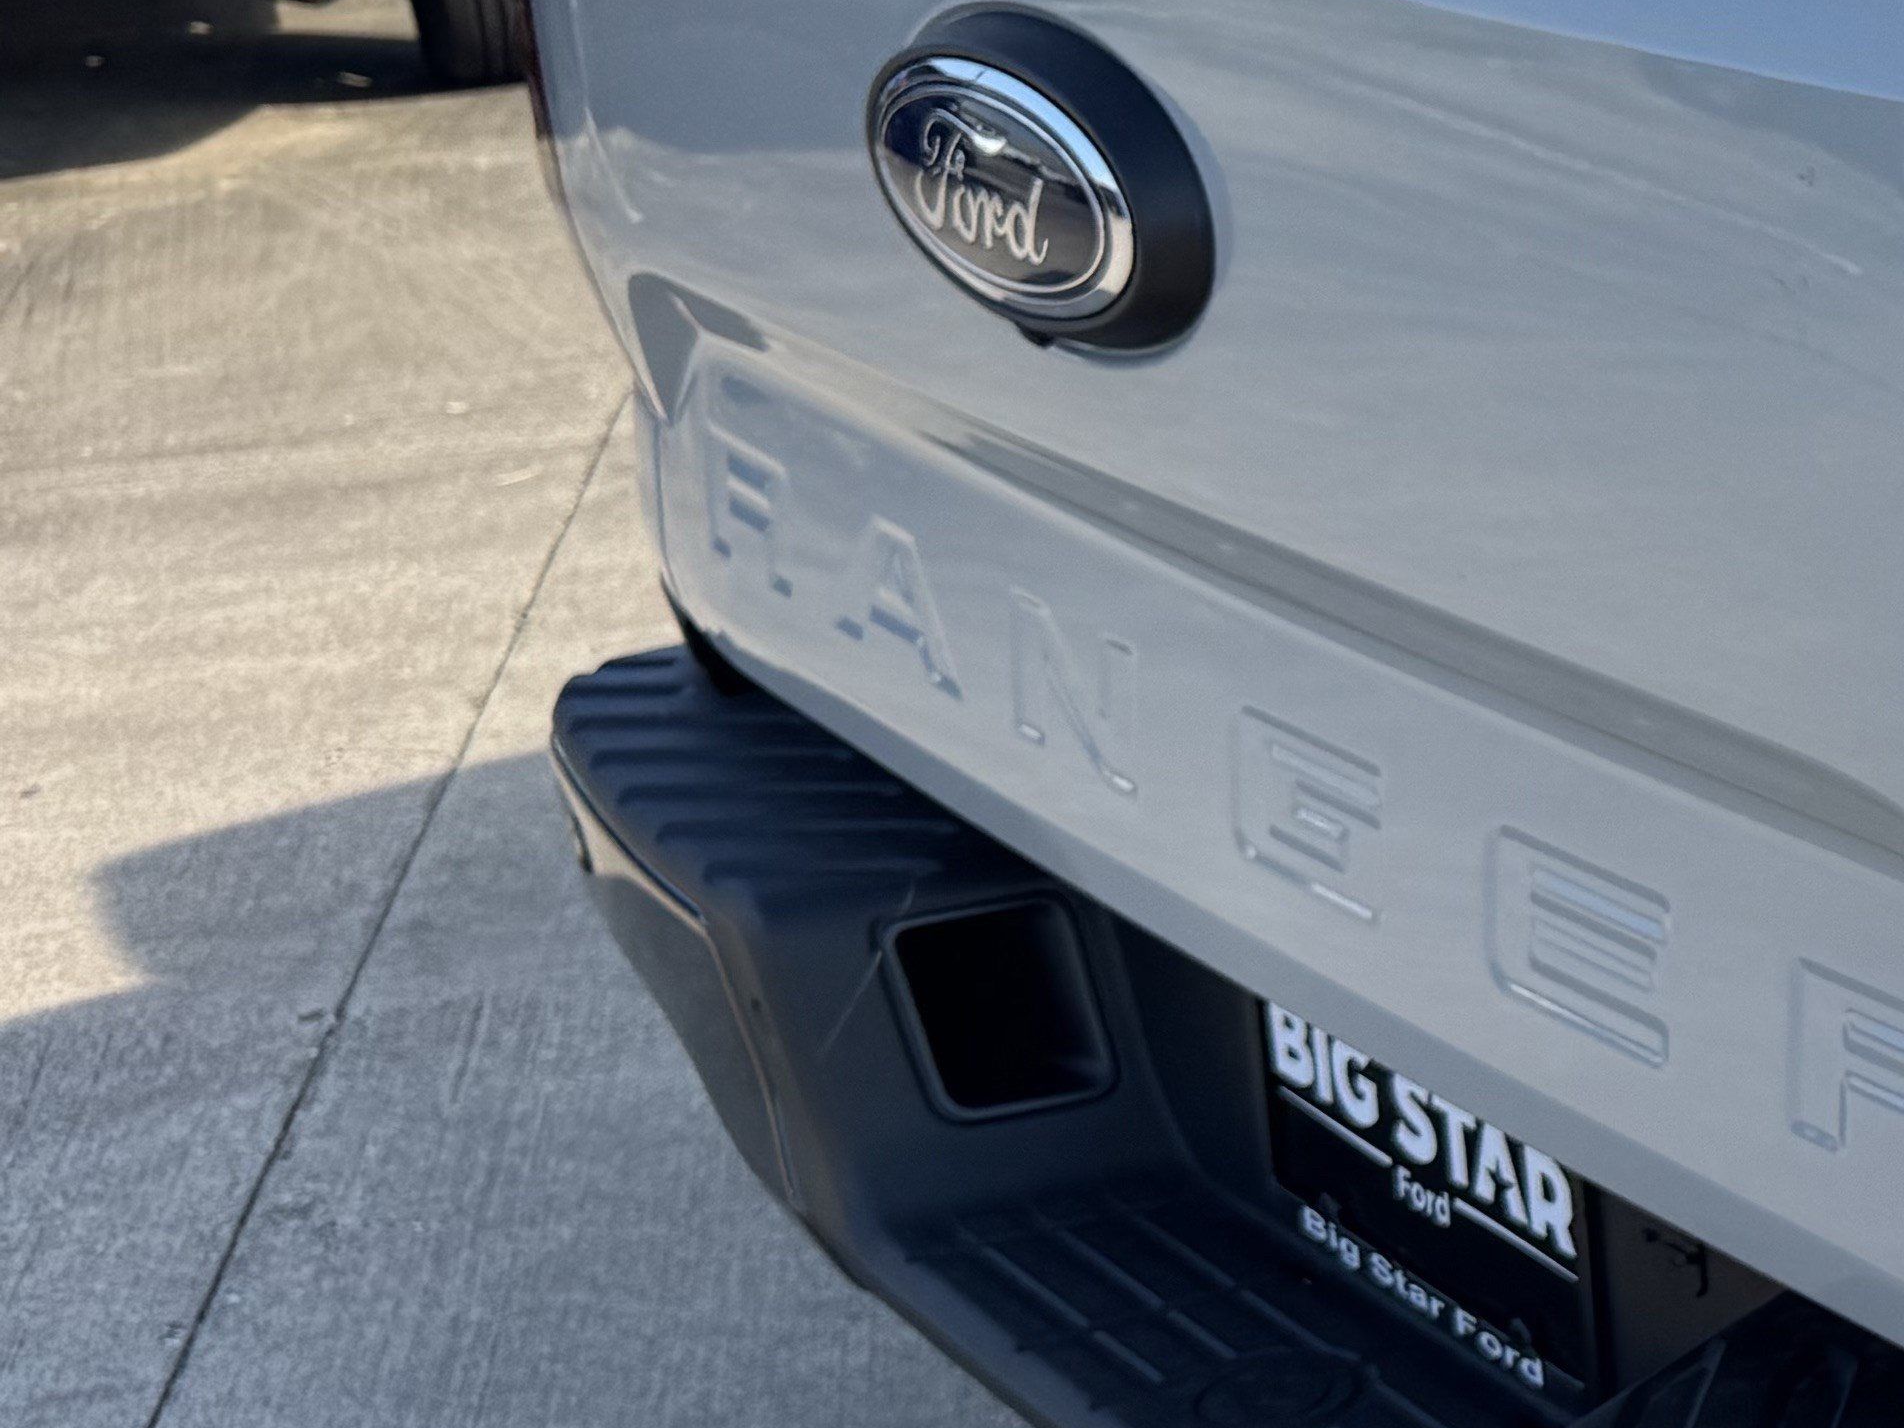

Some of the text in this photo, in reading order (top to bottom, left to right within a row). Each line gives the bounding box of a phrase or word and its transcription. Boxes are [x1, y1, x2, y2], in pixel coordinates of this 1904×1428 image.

[913, 106, 1050, 266] Ford
[1264, 1001, 1578, 1260] BIG STAR
[1391, 1165, 1452, 1229] Ford
[1300, 1204, 1545, 1390] Big Star Ford
